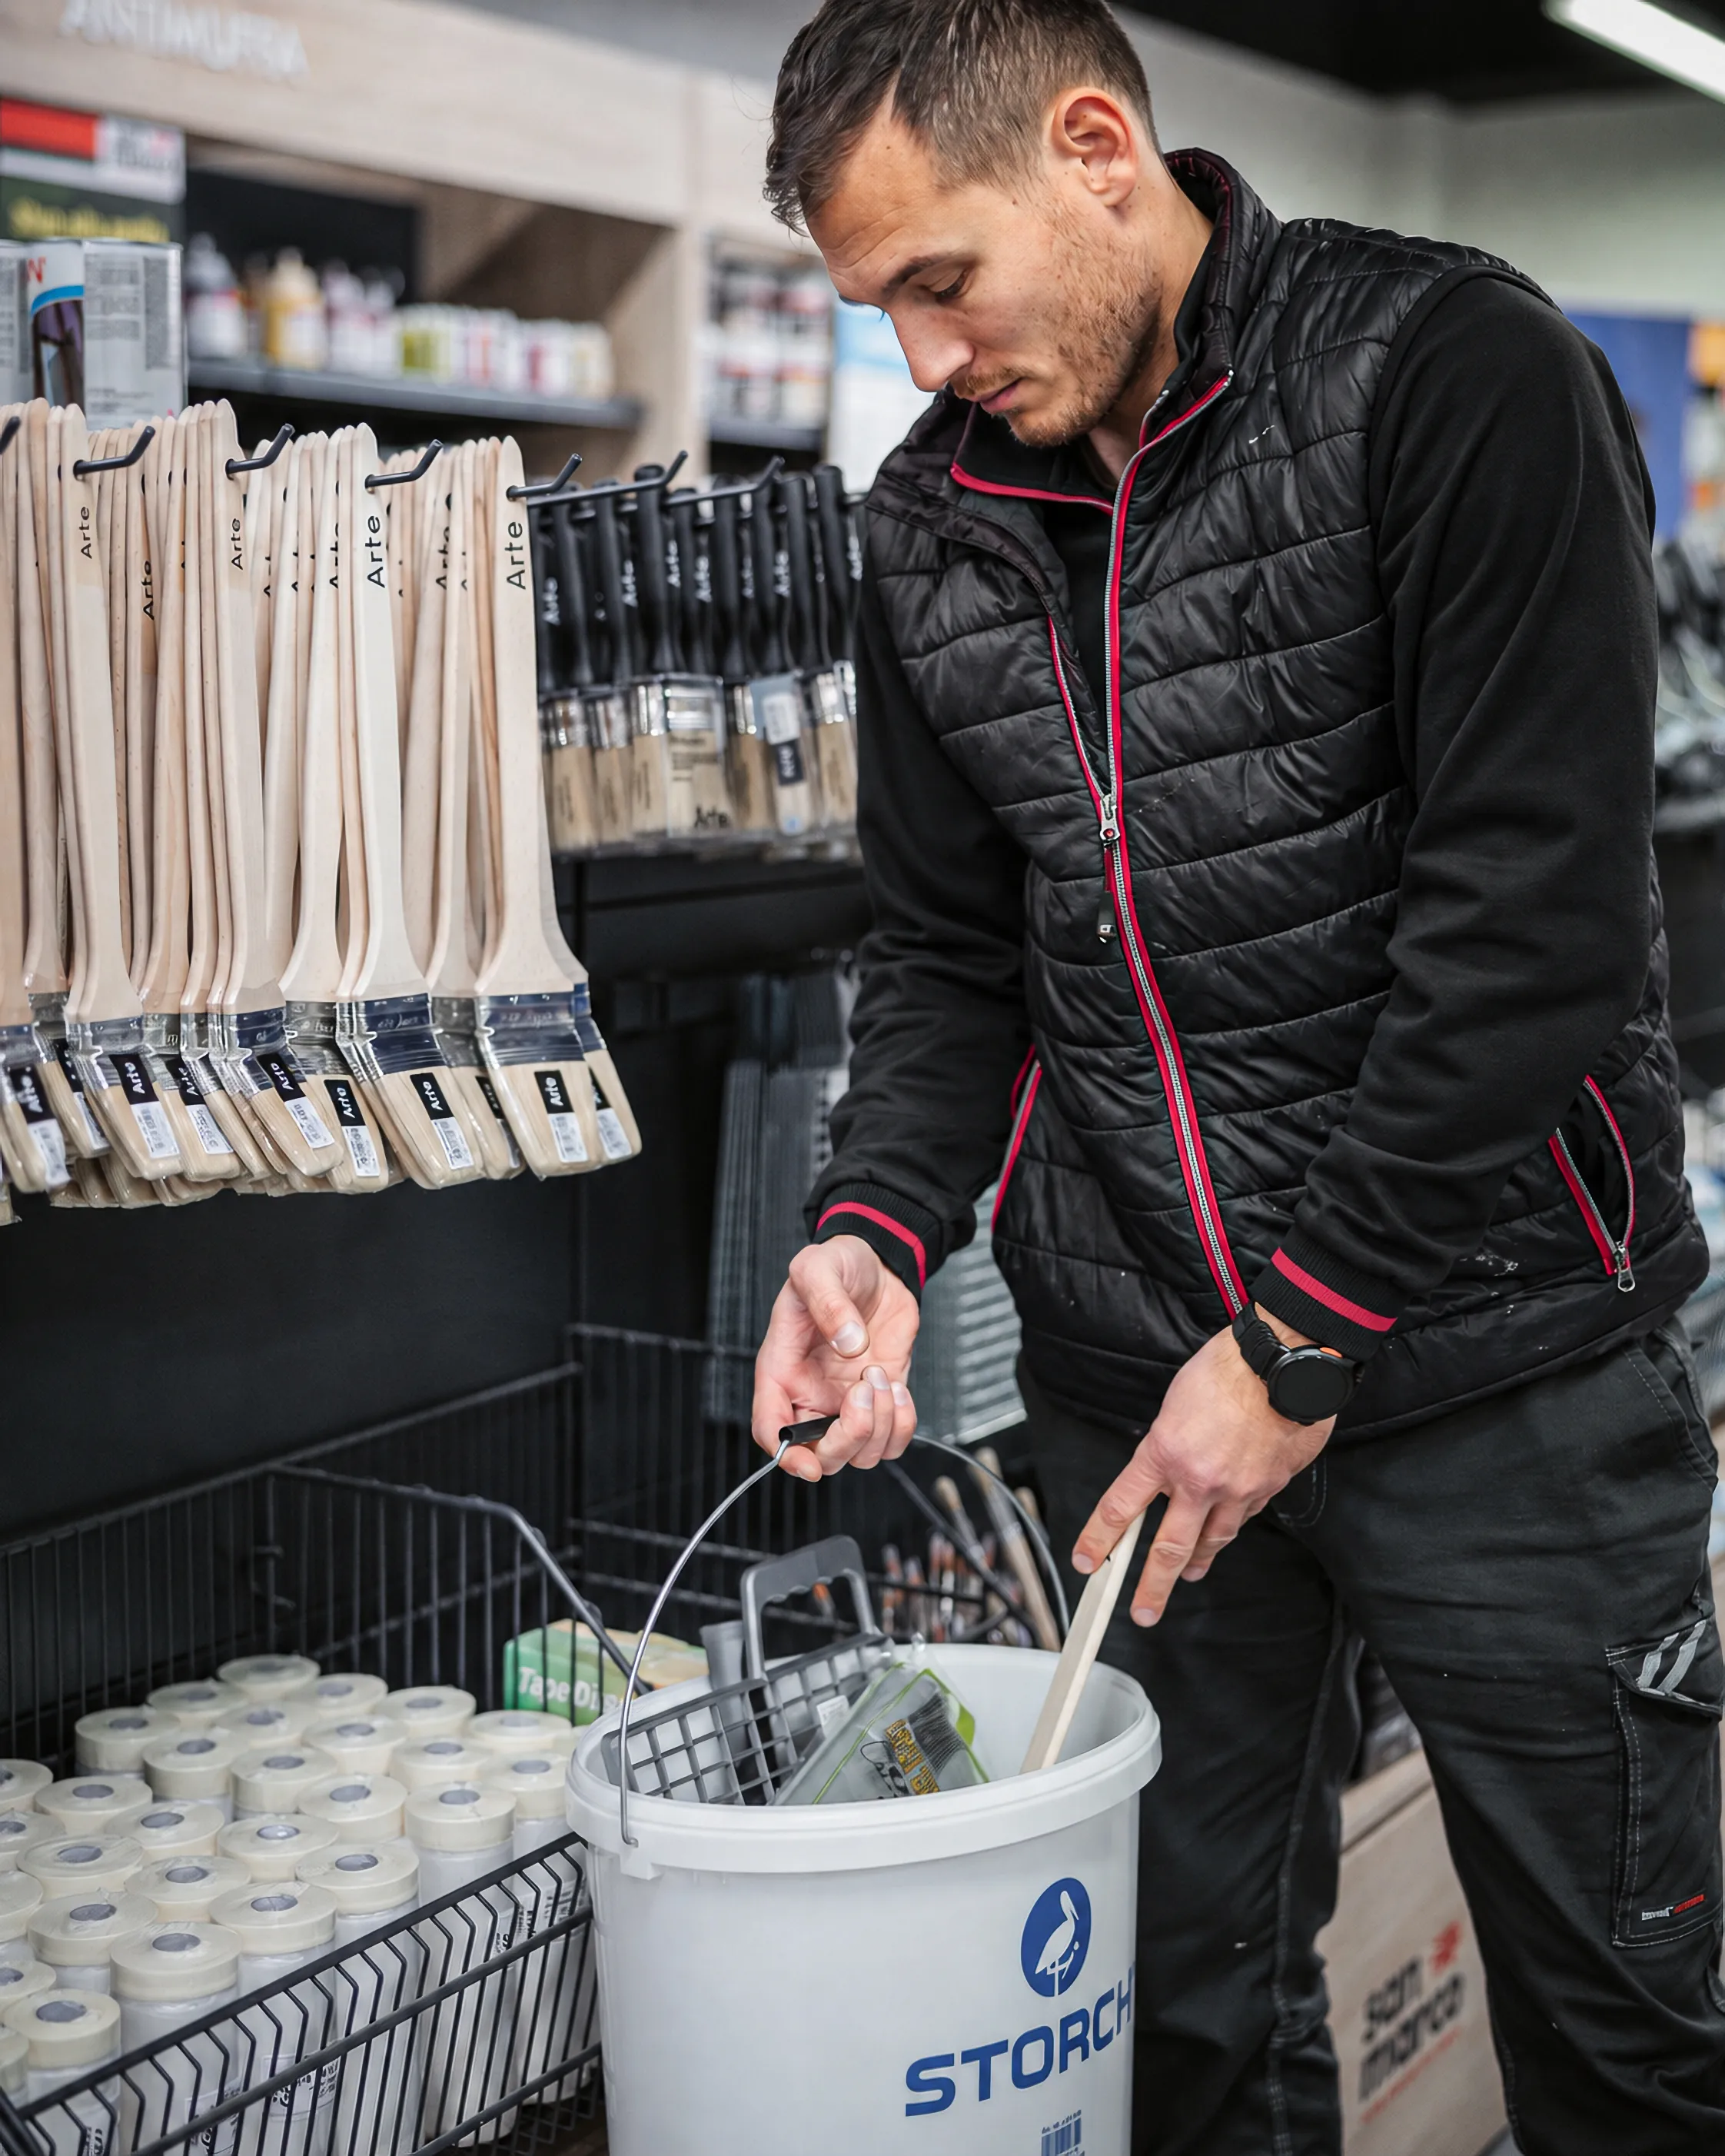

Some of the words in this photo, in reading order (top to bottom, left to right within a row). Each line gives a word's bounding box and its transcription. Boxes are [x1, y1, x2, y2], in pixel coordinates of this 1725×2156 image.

[78, 507, 92, 559] Arte
[231, 517, 244, 570] Arte
[365, 515, 386, 588] Arte
[504, 521, 526, 590] Arte
[141, 561, 155, 621] Arte
[906, 1961, 1135, 2117] STORCH
